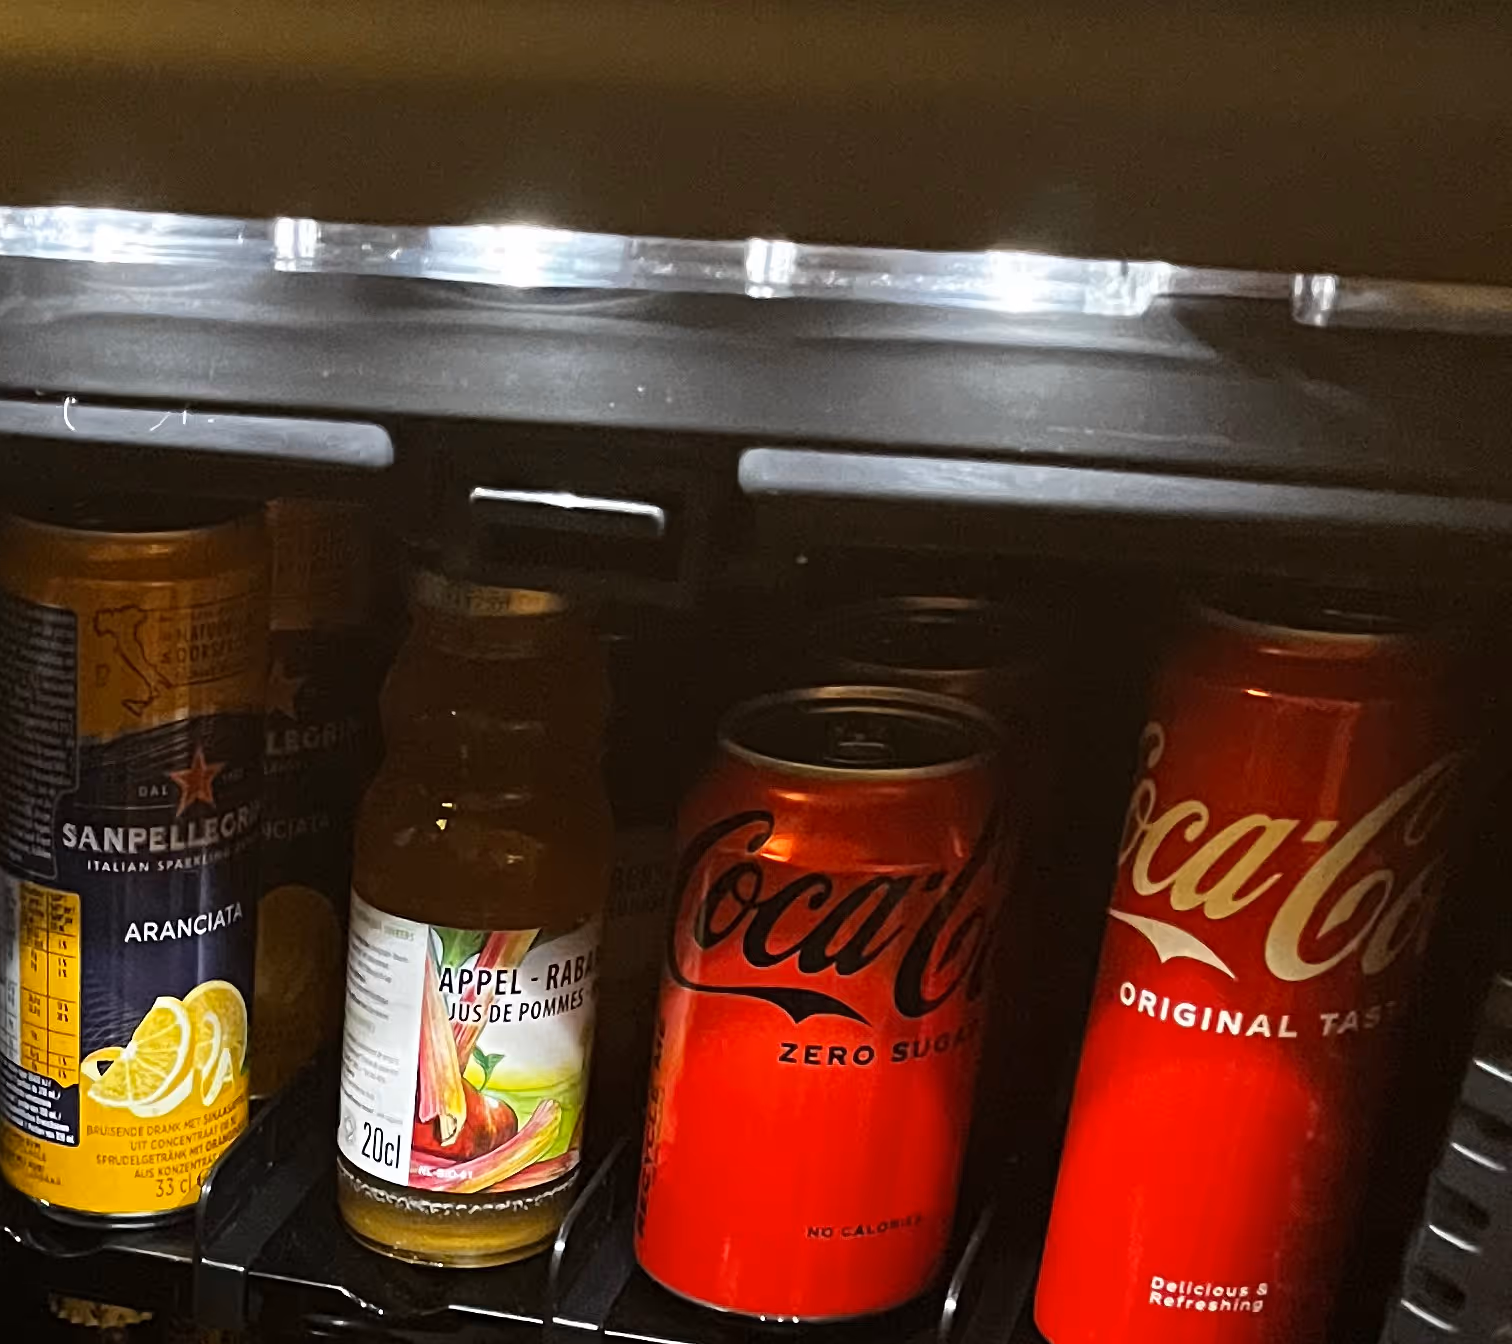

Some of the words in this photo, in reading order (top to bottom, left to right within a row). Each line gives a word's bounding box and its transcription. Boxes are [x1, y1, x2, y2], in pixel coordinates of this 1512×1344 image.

[87, 859, 150, 873] ITALIAN
[124, 901, 243, 944] ARANCIATA
[439, 966, 523, 996] APPEL
[448, 1001, 482, 1023] JUS
[488, 1001, 513, 1024] DE
[518, 987, 585, 1022] POMMES
[1119, 981, 1299, 1039] ORIGINAL
[778, 1042, 876, 1066] ZERO
[86, 1124, 144, 1138] BRUISENDE
[146, 1122, 181, 1137] DRANK
[183, 1115, 202, 1129] MET
[130, 1140, 148, 1152] UIT
[150, 1127, 219, 1151] CONCENTRAAT
[134, 1168, 155, 1179] AUS
[155, 1177, 175, 1198] 33
[806, 1225, 834, 1239] NO
[1150, 1275, 1250, 1298] Delicious
[1148, 1290, 1264, 1313] Refreshing
